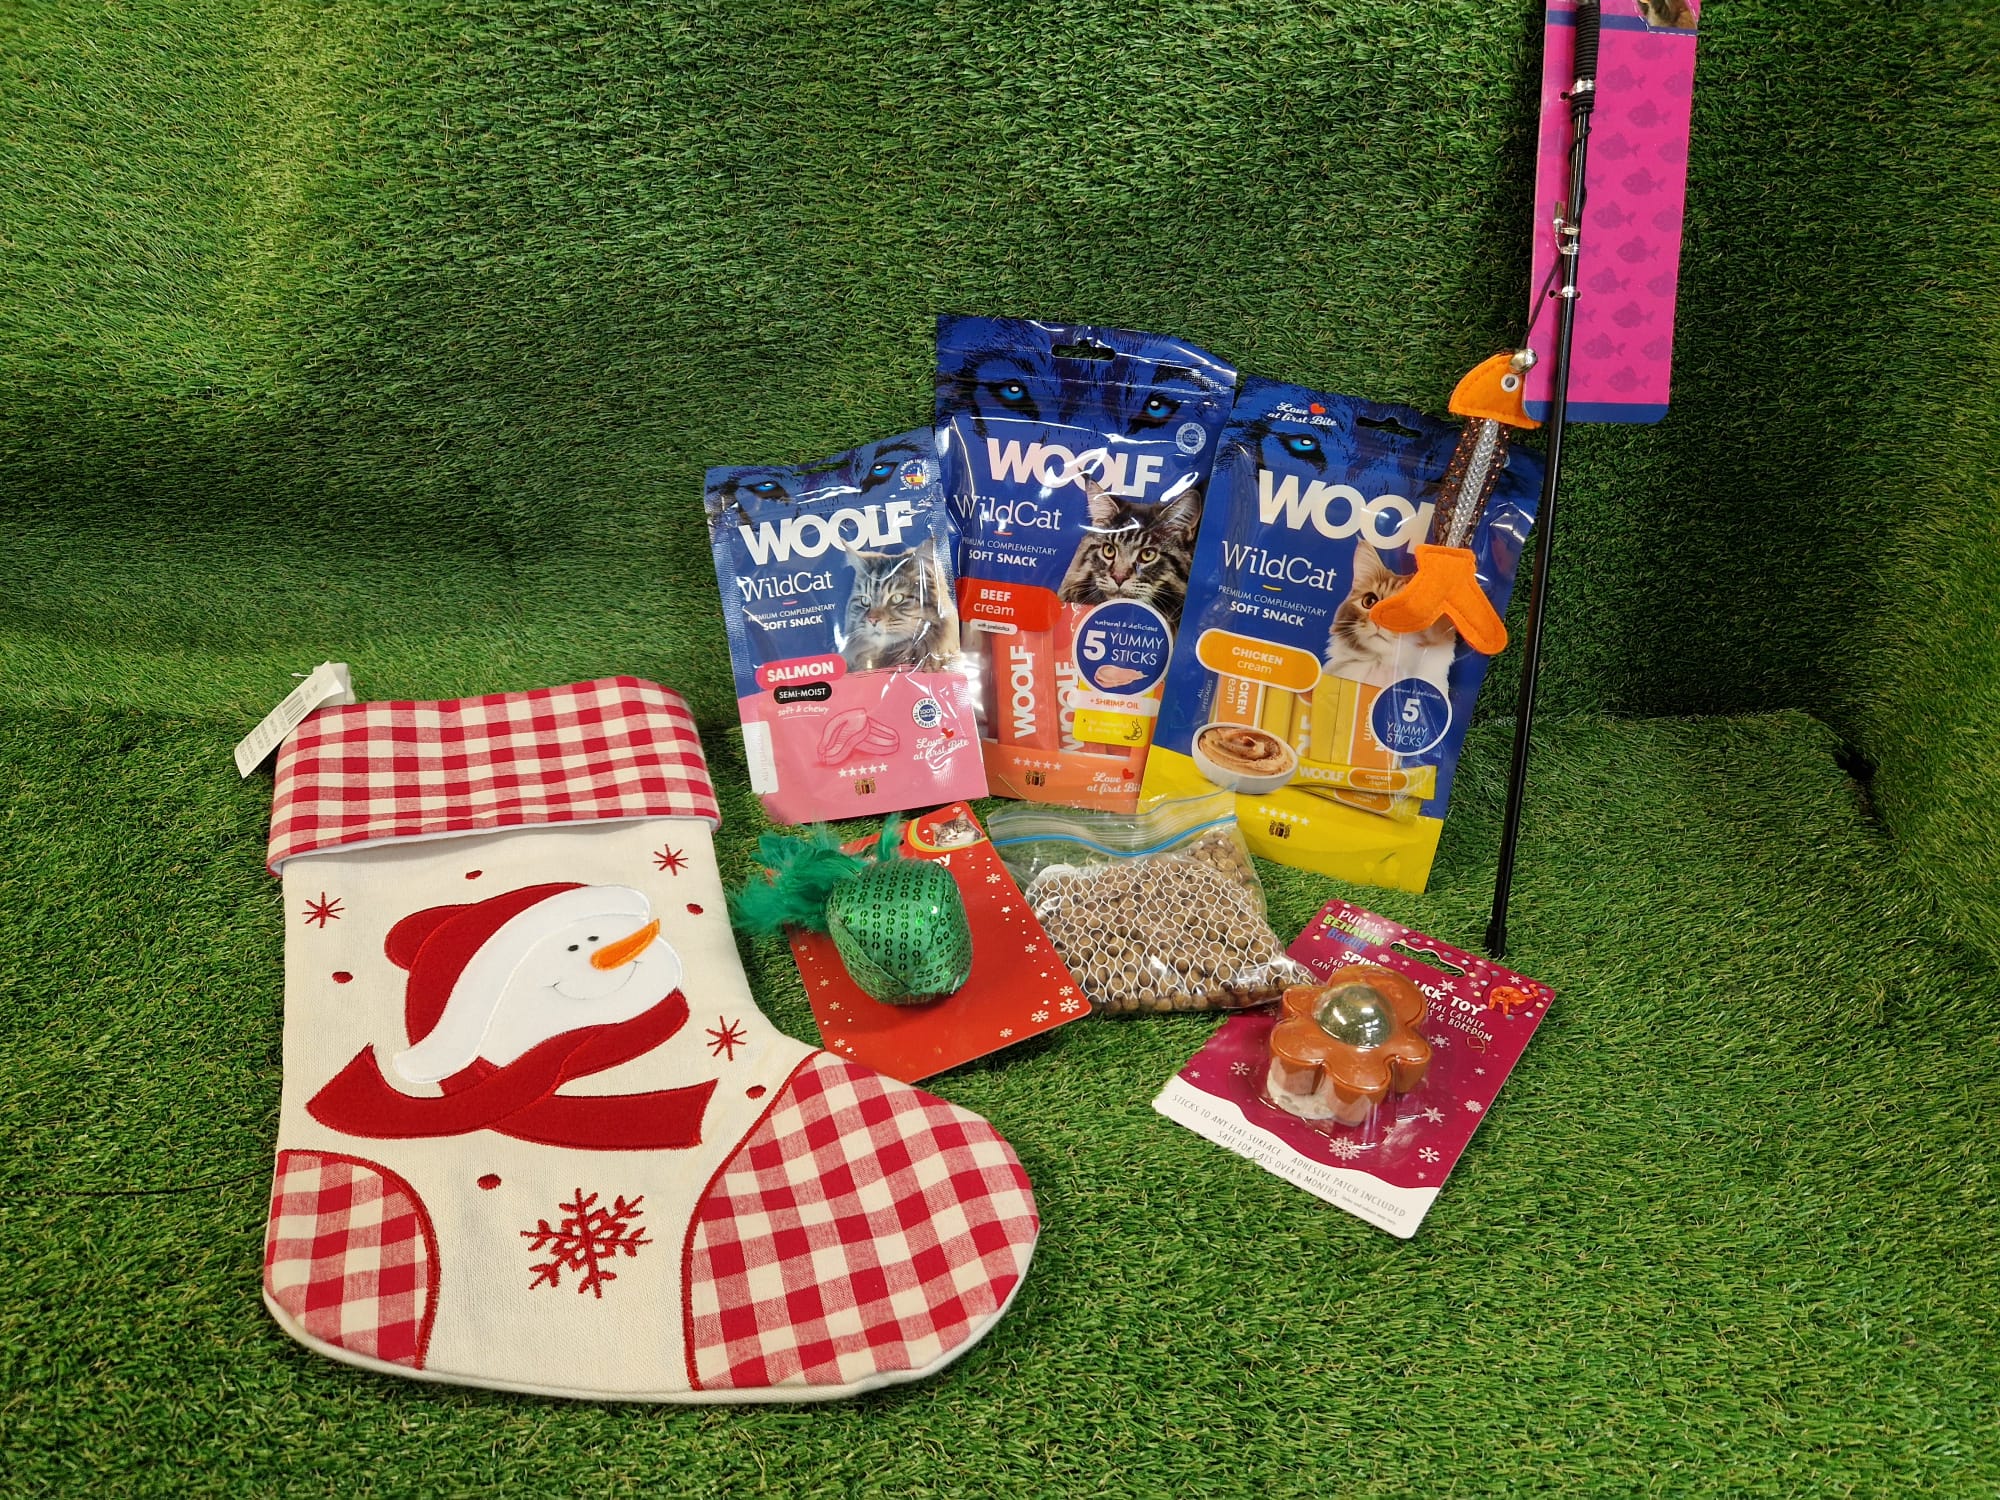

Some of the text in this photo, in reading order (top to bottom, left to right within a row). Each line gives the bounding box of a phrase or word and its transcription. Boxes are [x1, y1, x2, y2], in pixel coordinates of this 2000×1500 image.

[1276, 402, 1309, 415] Love
[1281, 412, 1308, 424] first
[1309, 415, 1337, 426] Bite
[987, 437, 1164, 498] WOOLF
[953, 494, 1062, 531] WildCat
[1259, 469, 1437, 554] WOOL
[738, 500, 914, 566] WOOLF
[987, 540, 1057, 556] COMPLEMENTARY
[968, 549, 1038, 568] SOFT SNACK
[1222, 540, 1337, 591] WildCat
[737, 571, 834, 602] WildCat
[980, 588, 1012, 603] BEEF
[973, 602, 1015, 617] cream
[1218, 584, 1328, 617] PREMIUM COMPLEMENTARY
[780, 603, 836, 618] COMPLEMENTARY
[1230, 600, 1305, 627] SOFT SNACK
[763, 614, 824, 631] SOFT SNACK
[1095, 619, 1121, 628] natural
[1083, 629, 1106, 661] 5
[1110, 631, 1164, 650] YUMMY
[1111, 648, 1157, 666] STICKS
[1231, 646, 1284, 665] CHICKEN
[767, 661, 834, 683] SALMON
[1237, 660, 1273, 675] cream
[779, 687, 826, 699] SEMI-MOIST
[1010, 645, 1036, 739] WOOLF
[1225, 678, 1237, 704] eam
[1235, 681, 1250, 715] CKEN
[803, 704, 829, 715] chewy
[1095, 697, 1125, 708] SHRIMP
[1126, 701, 1139, 710] OIL
[1402, 697, 1420, 723] 5
[1387, 720, 1428, 736] YUMMY
[1386, 732, 1422, 747] STICKS
[1093, 771, 1121, 783] Love
[1299, 764, 1345, 782] WOOLF
[1087, 782, 1140, 795] at first Bit
[1311, 958, 1331, 971] CAN
[1448, 1018, 1493, 1042] BOREDOM
[1450, 995, 1484, 1016] TOY
[1449, 1010, 1485, 1029] CATNIP
[1173, 1094, 1199, 1113] STICKS
[1200, 1108, 1212, 1118] TO
[1212, 1115, 1229, 1128] ANY
[1228, 1123, 1248, 1138] FLAT
[1248, 1133, 1281, 1157] SURFACE
[1291, 1156, 1331, 1181] ADHESIVE
[1332, 1177, 1359, 1195] PATCH
[1359, 1190, 1406, 1218] INCLUDED
[1217, 1130, 1238, 1145] SAFE
[1237, 1140, 1252, 1154] FOR
[1253, 1149, 1274, 1166] CATS
[1274, 1160, 1296, 1176] OVER
[1303, 1175, 1338, 1198] MONTHS
